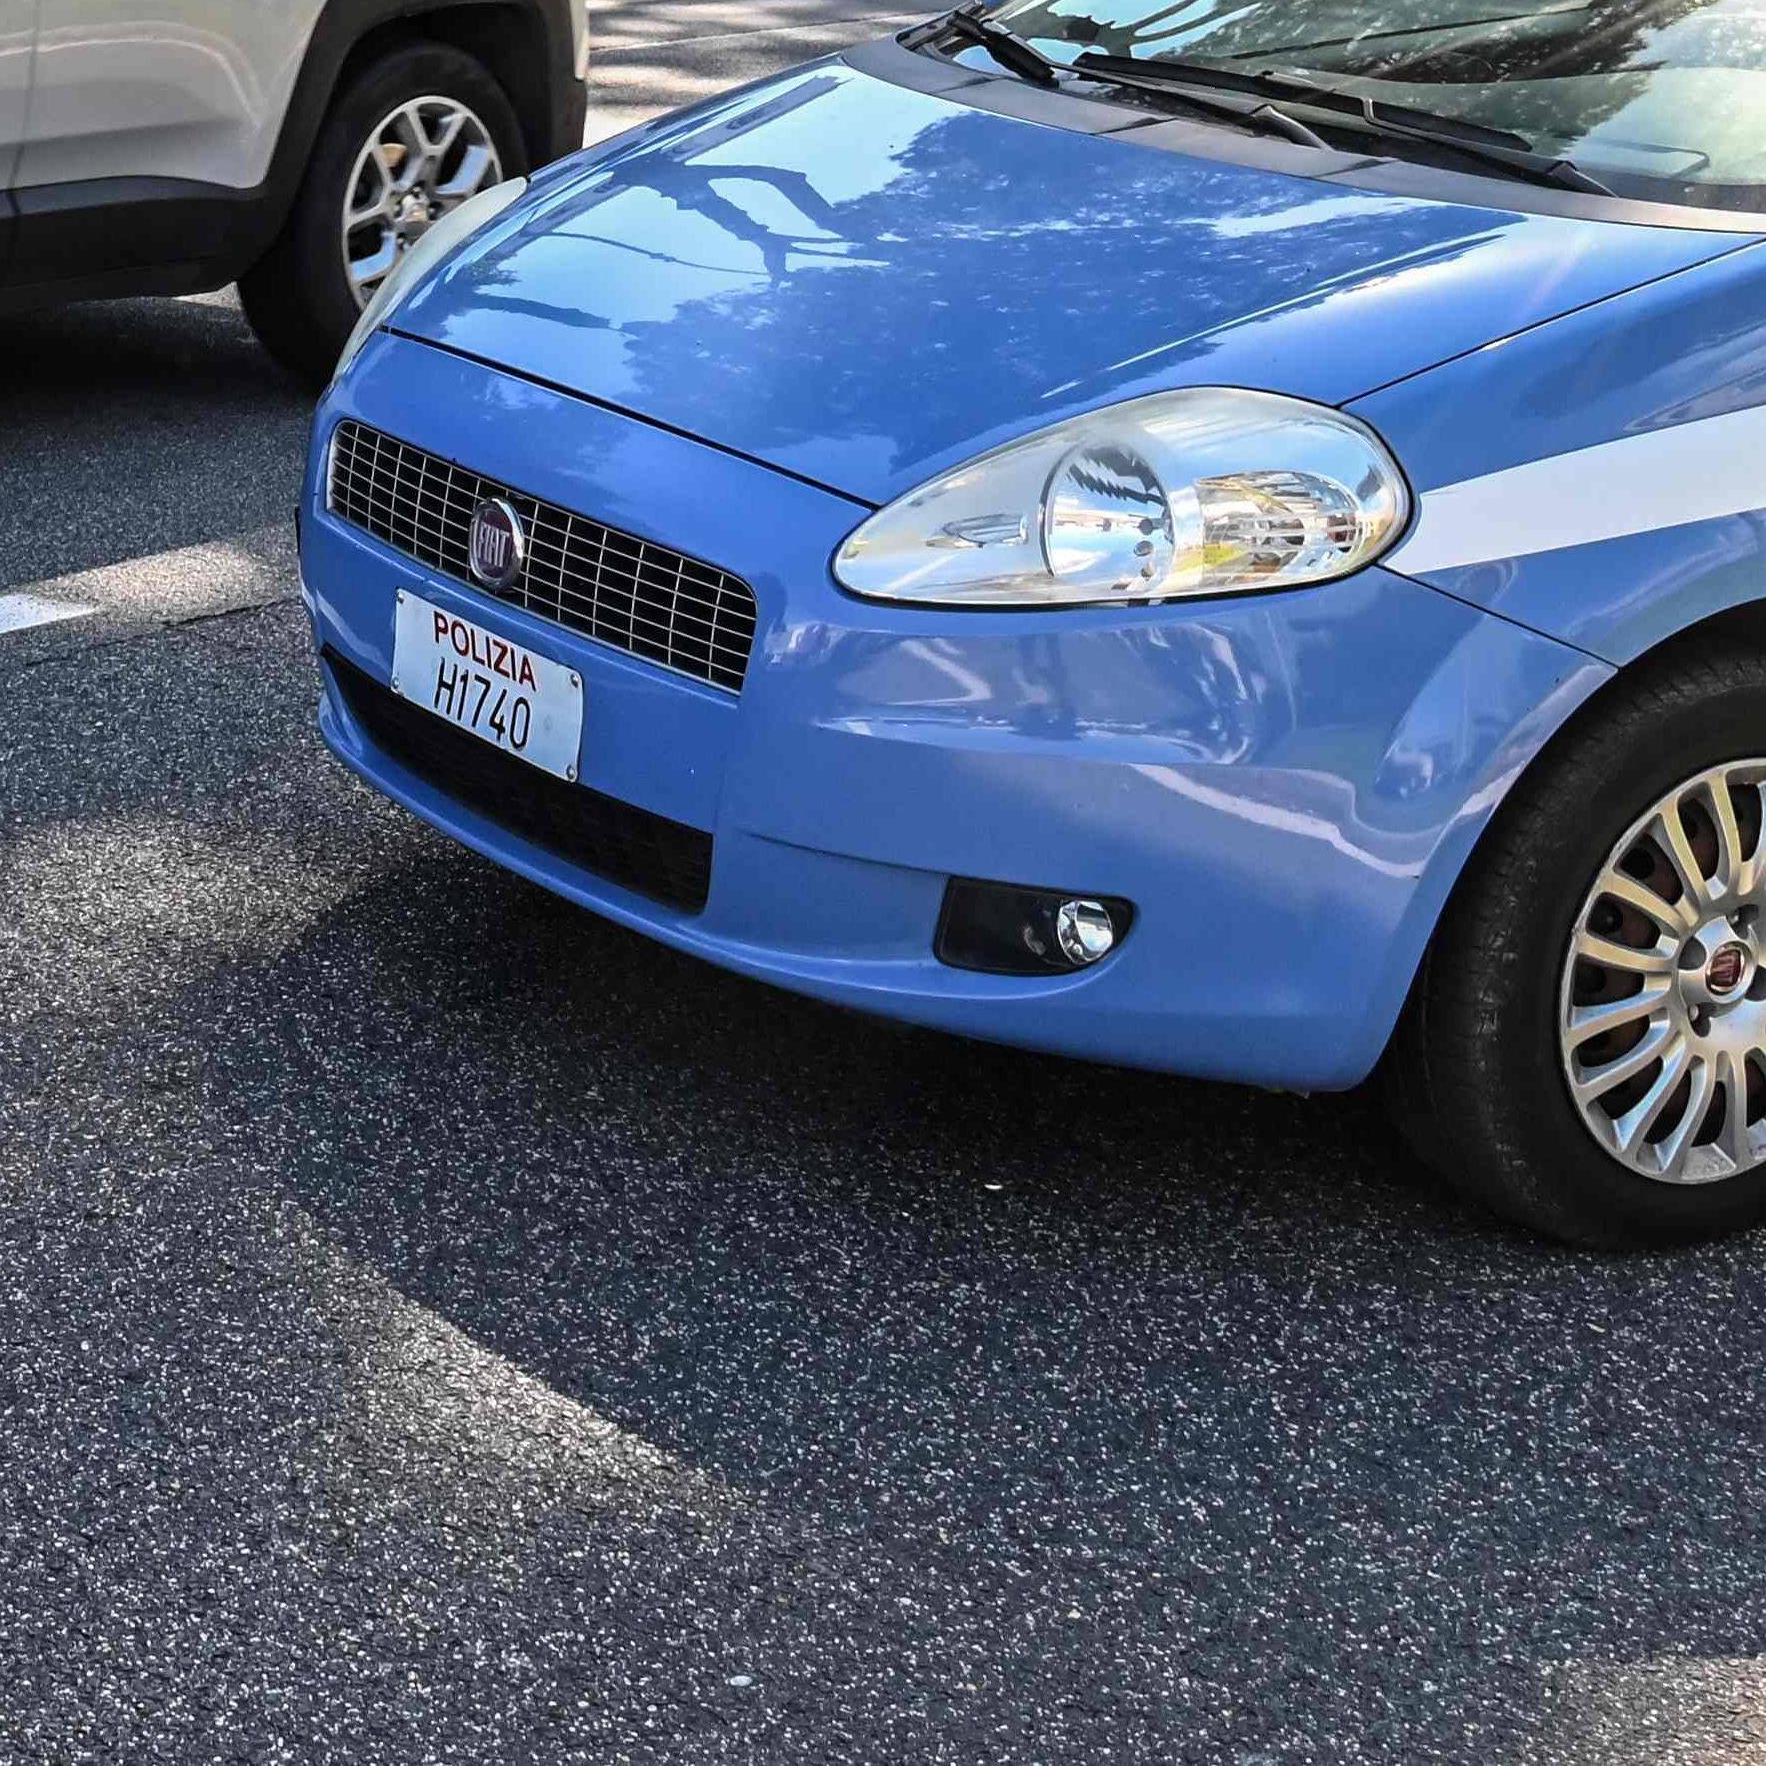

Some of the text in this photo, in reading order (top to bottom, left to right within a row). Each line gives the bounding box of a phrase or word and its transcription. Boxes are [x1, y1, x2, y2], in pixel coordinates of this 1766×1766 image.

[477, 520, 510, 568] FIAT
[432, 610, 537, 692] POLIZIA
[434, 656, 531, 752] H1740
